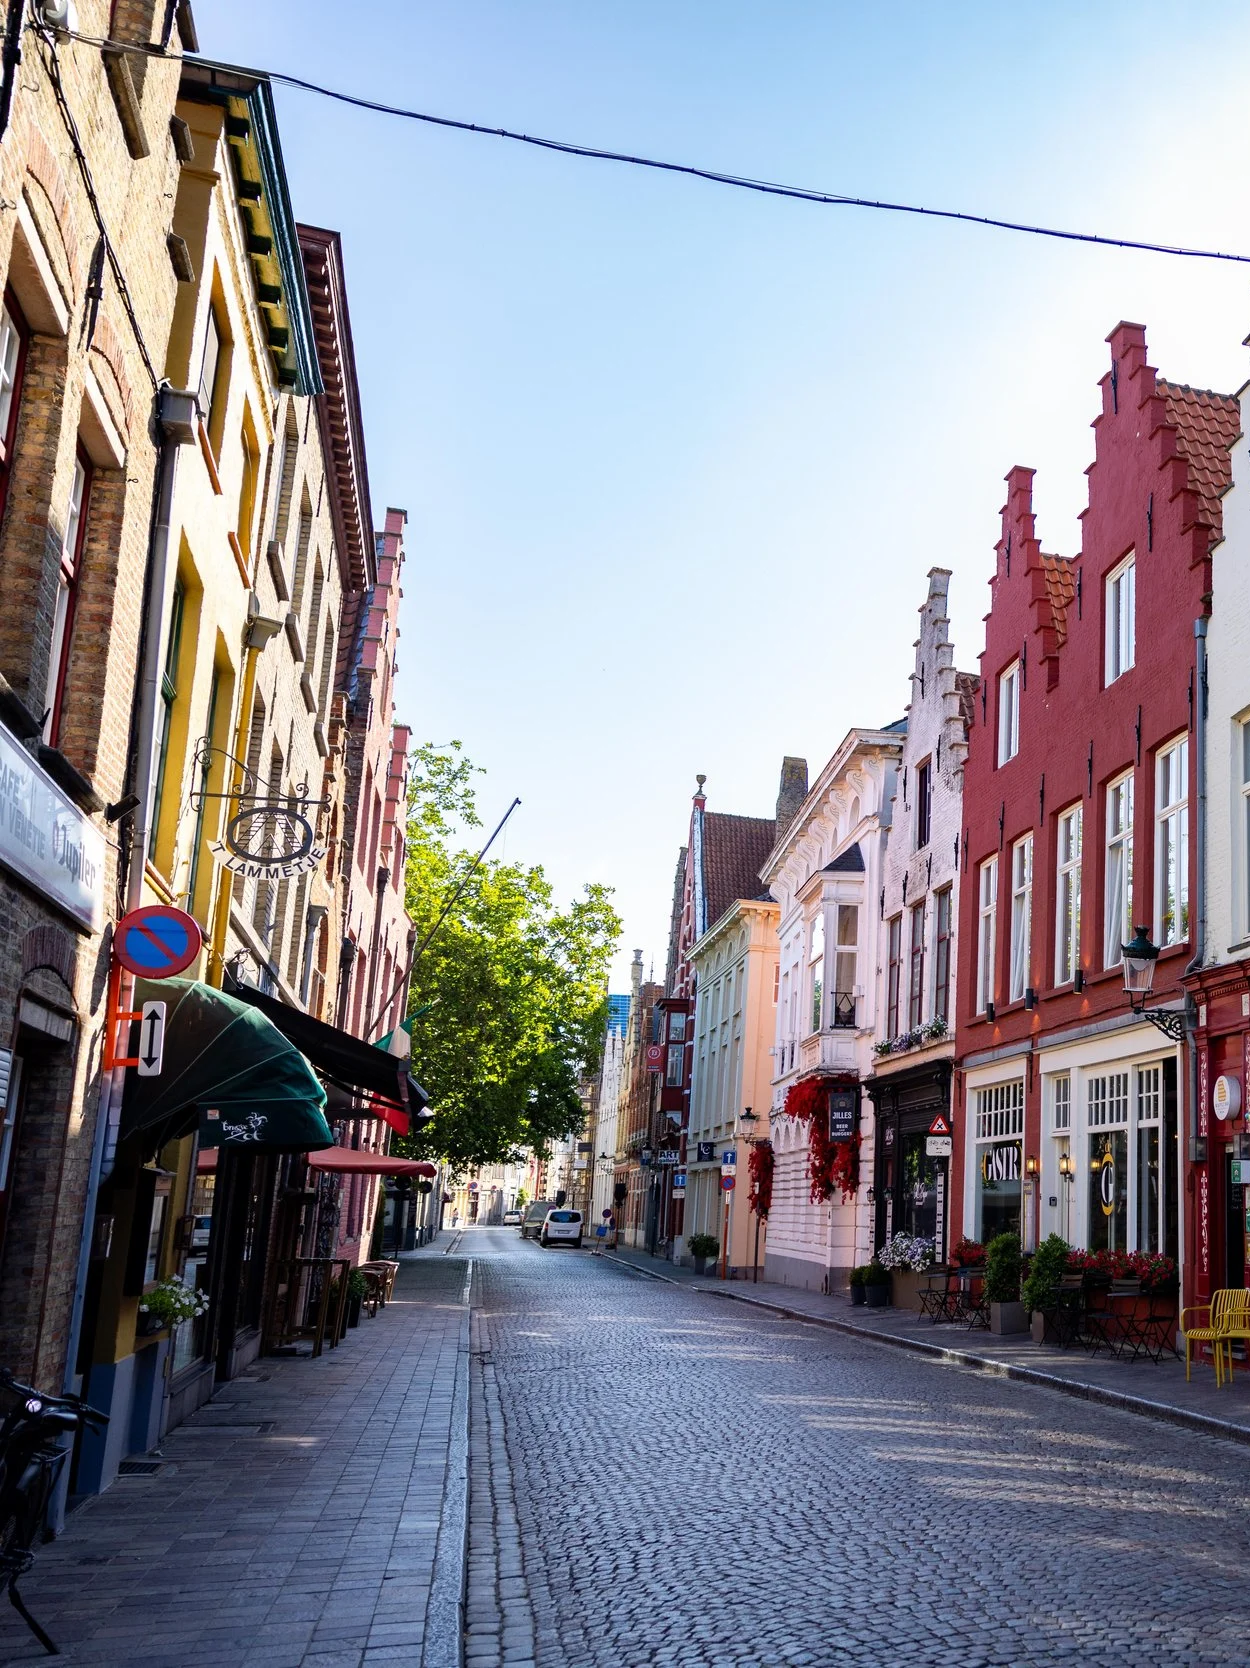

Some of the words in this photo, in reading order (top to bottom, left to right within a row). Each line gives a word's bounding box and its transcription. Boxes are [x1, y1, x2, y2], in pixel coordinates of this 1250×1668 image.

[0, 757, 20, 807] AFE
[58, 824, 96, 889] Jupiler
[225, 848, 325, 879] LAMMETJE
[832, 1111, 852, 1119] JILLES
